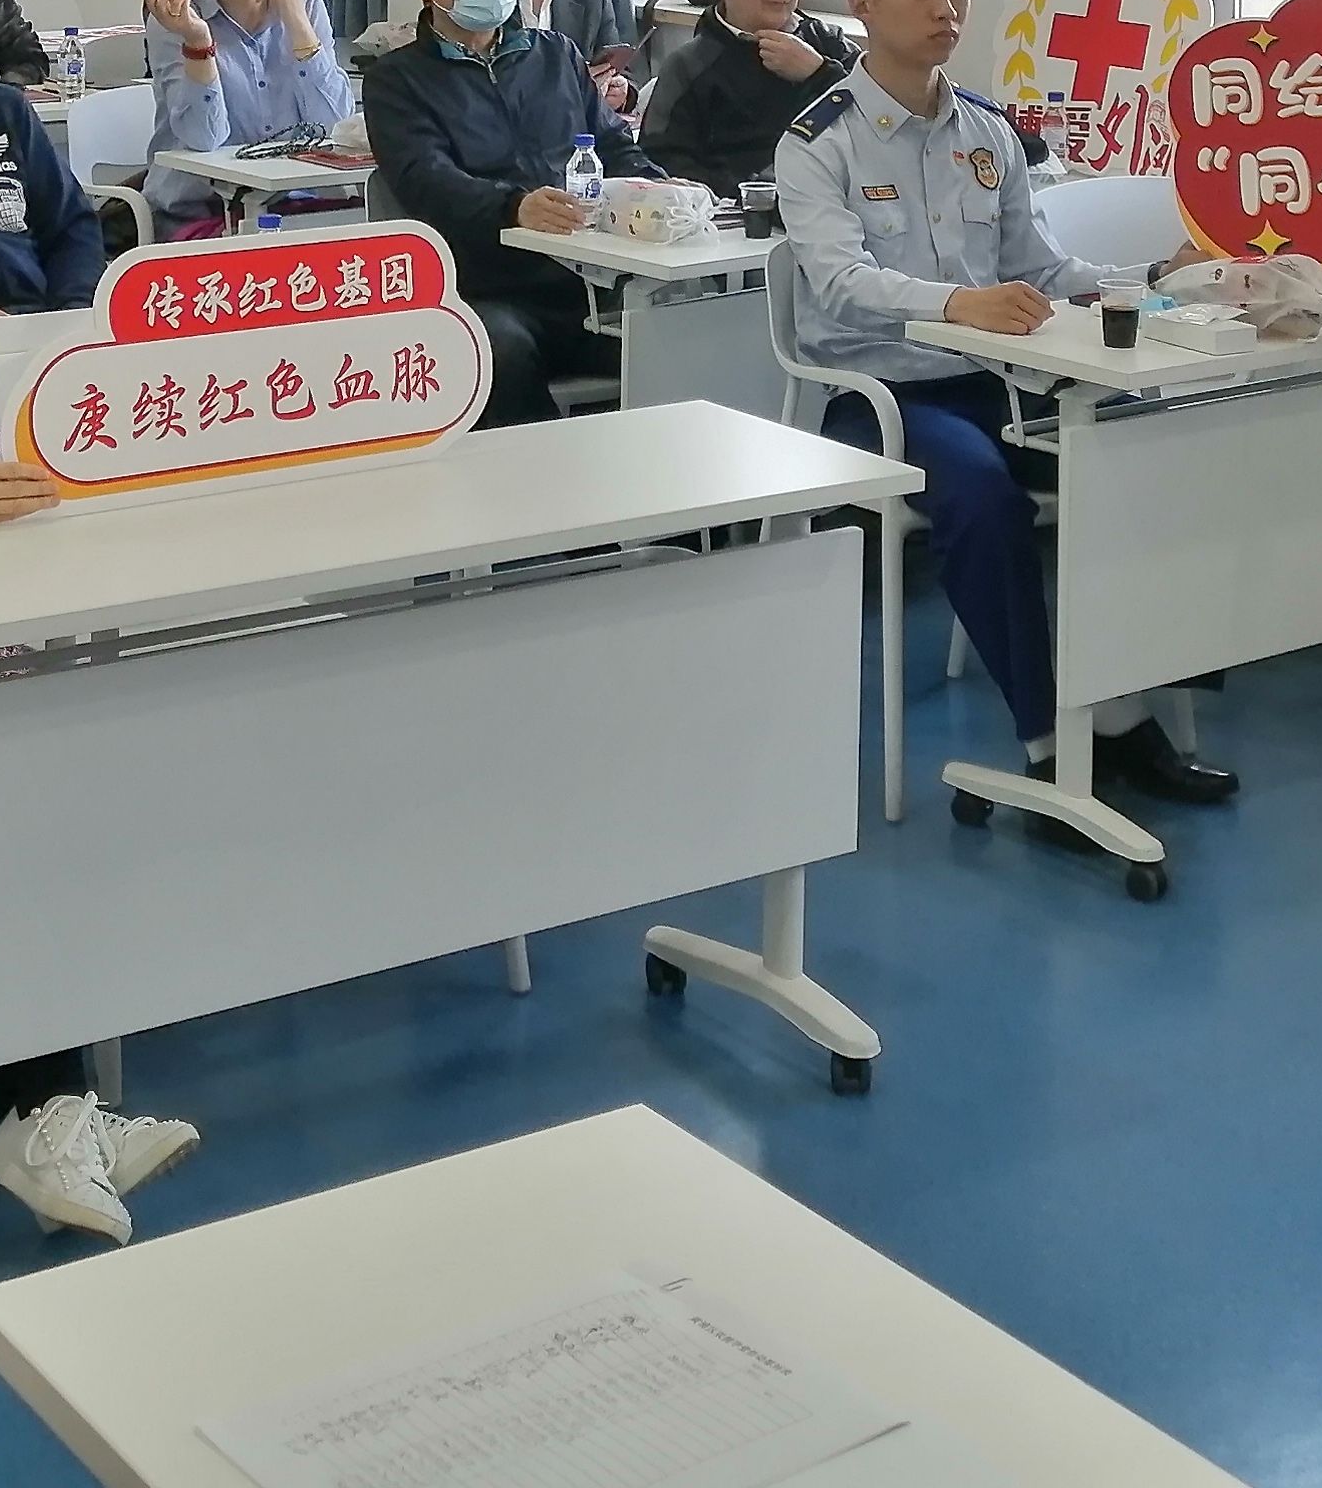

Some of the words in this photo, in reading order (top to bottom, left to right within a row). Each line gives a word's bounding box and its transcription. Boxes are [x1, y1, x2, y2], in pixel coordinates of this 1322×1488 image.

[142, 251, 414, 330] 传承红色基因
